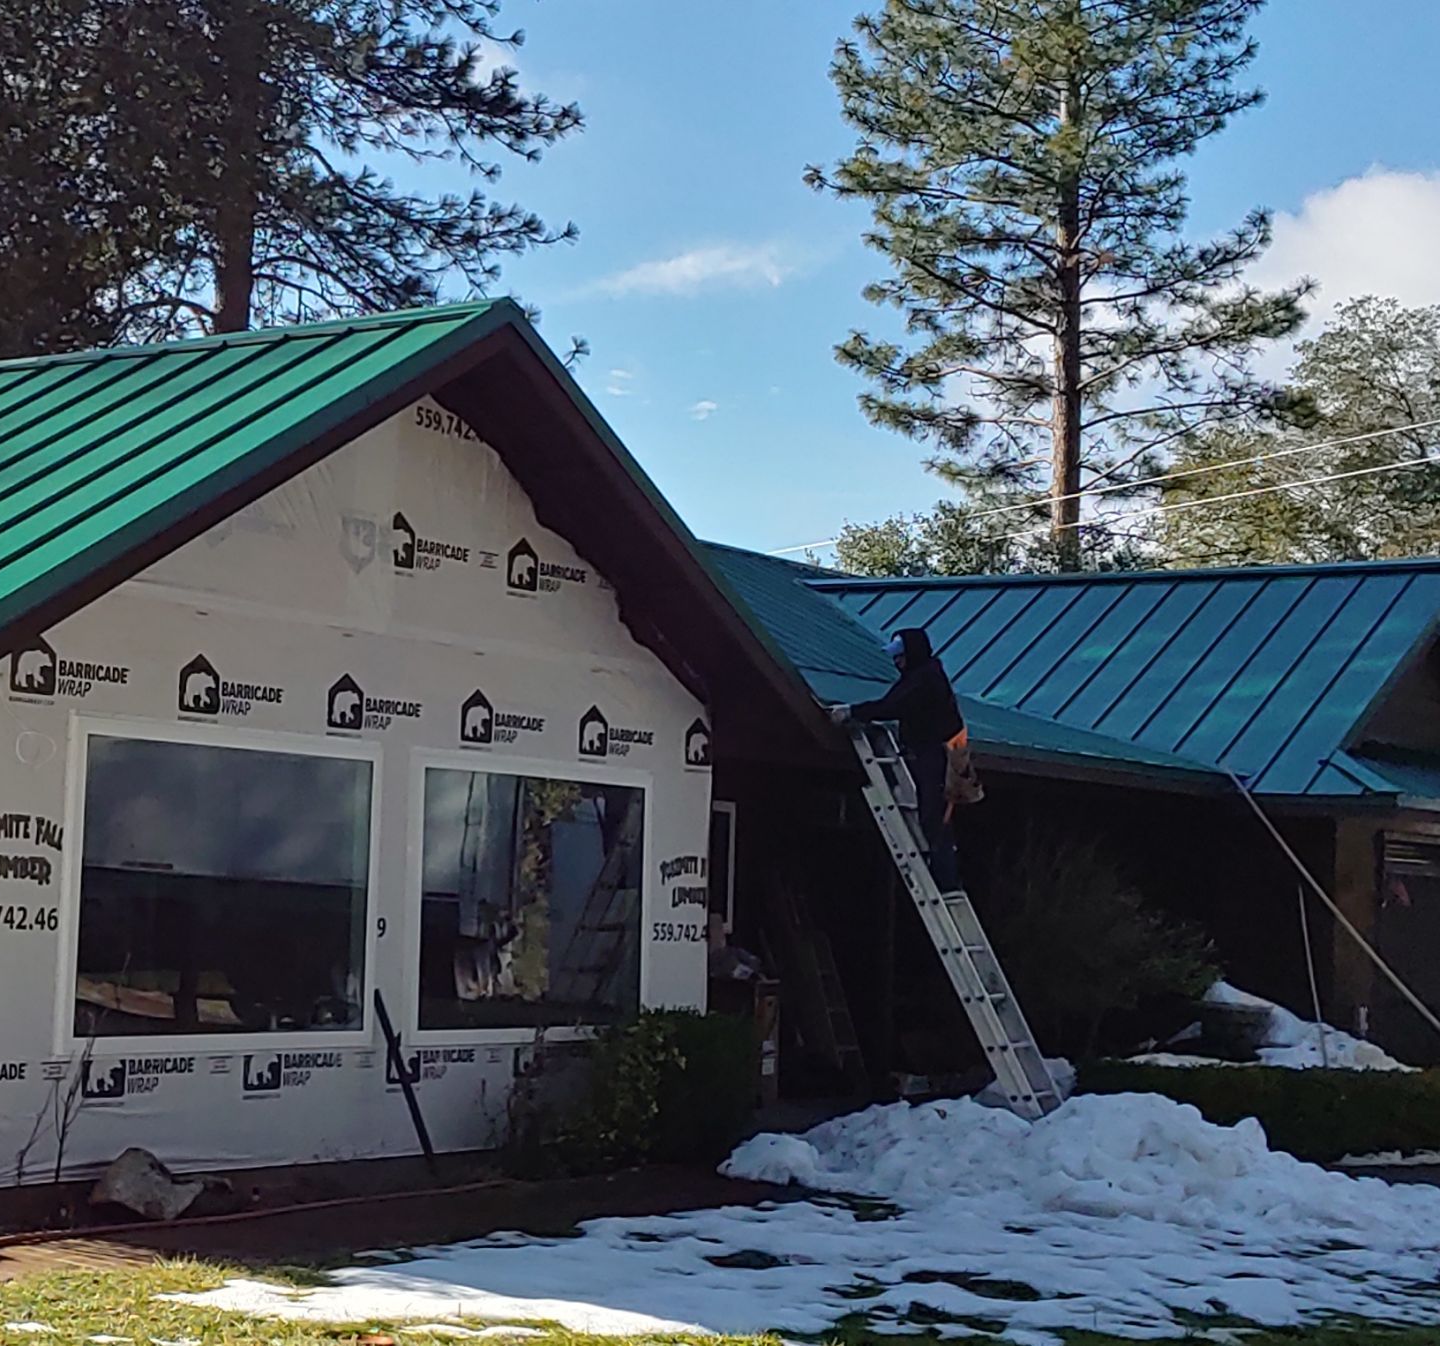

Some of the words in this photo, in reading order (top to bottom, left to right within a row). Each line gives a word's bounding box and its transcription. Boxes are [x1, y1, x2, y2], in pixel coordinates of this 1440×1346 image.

[416, 538, 470, 562] BARRICADE
[415, 554, 440, 571] WRAP
[539, 562, 587, 583] BARRICADE
[538, 576, 561, 592] WRAP
[59, 660, 129, 683] BARRICADE
[57, 678, 91, 697] WRAP
[221, 682, 283, 703] BARRICADE
[220, 699, 251, 716] WRAP
[365, 697, 422, 717] BARRICADE
[364, 715, 391, 730] WRAP
[494, 713, 545, 732] BARRICADE
[493, 729, 517, 743] WRAP
[609, 727, 654, 745] BARRICADE
[377, 917, 386, 938] 9
[128, 1057, 195, 1075] BARRICADE
[284, 1053, 342, 1069] BARRICADE
[126, 1077, 158, 1094] WRAP
[283, 1070, 311, 1087] WRAP
